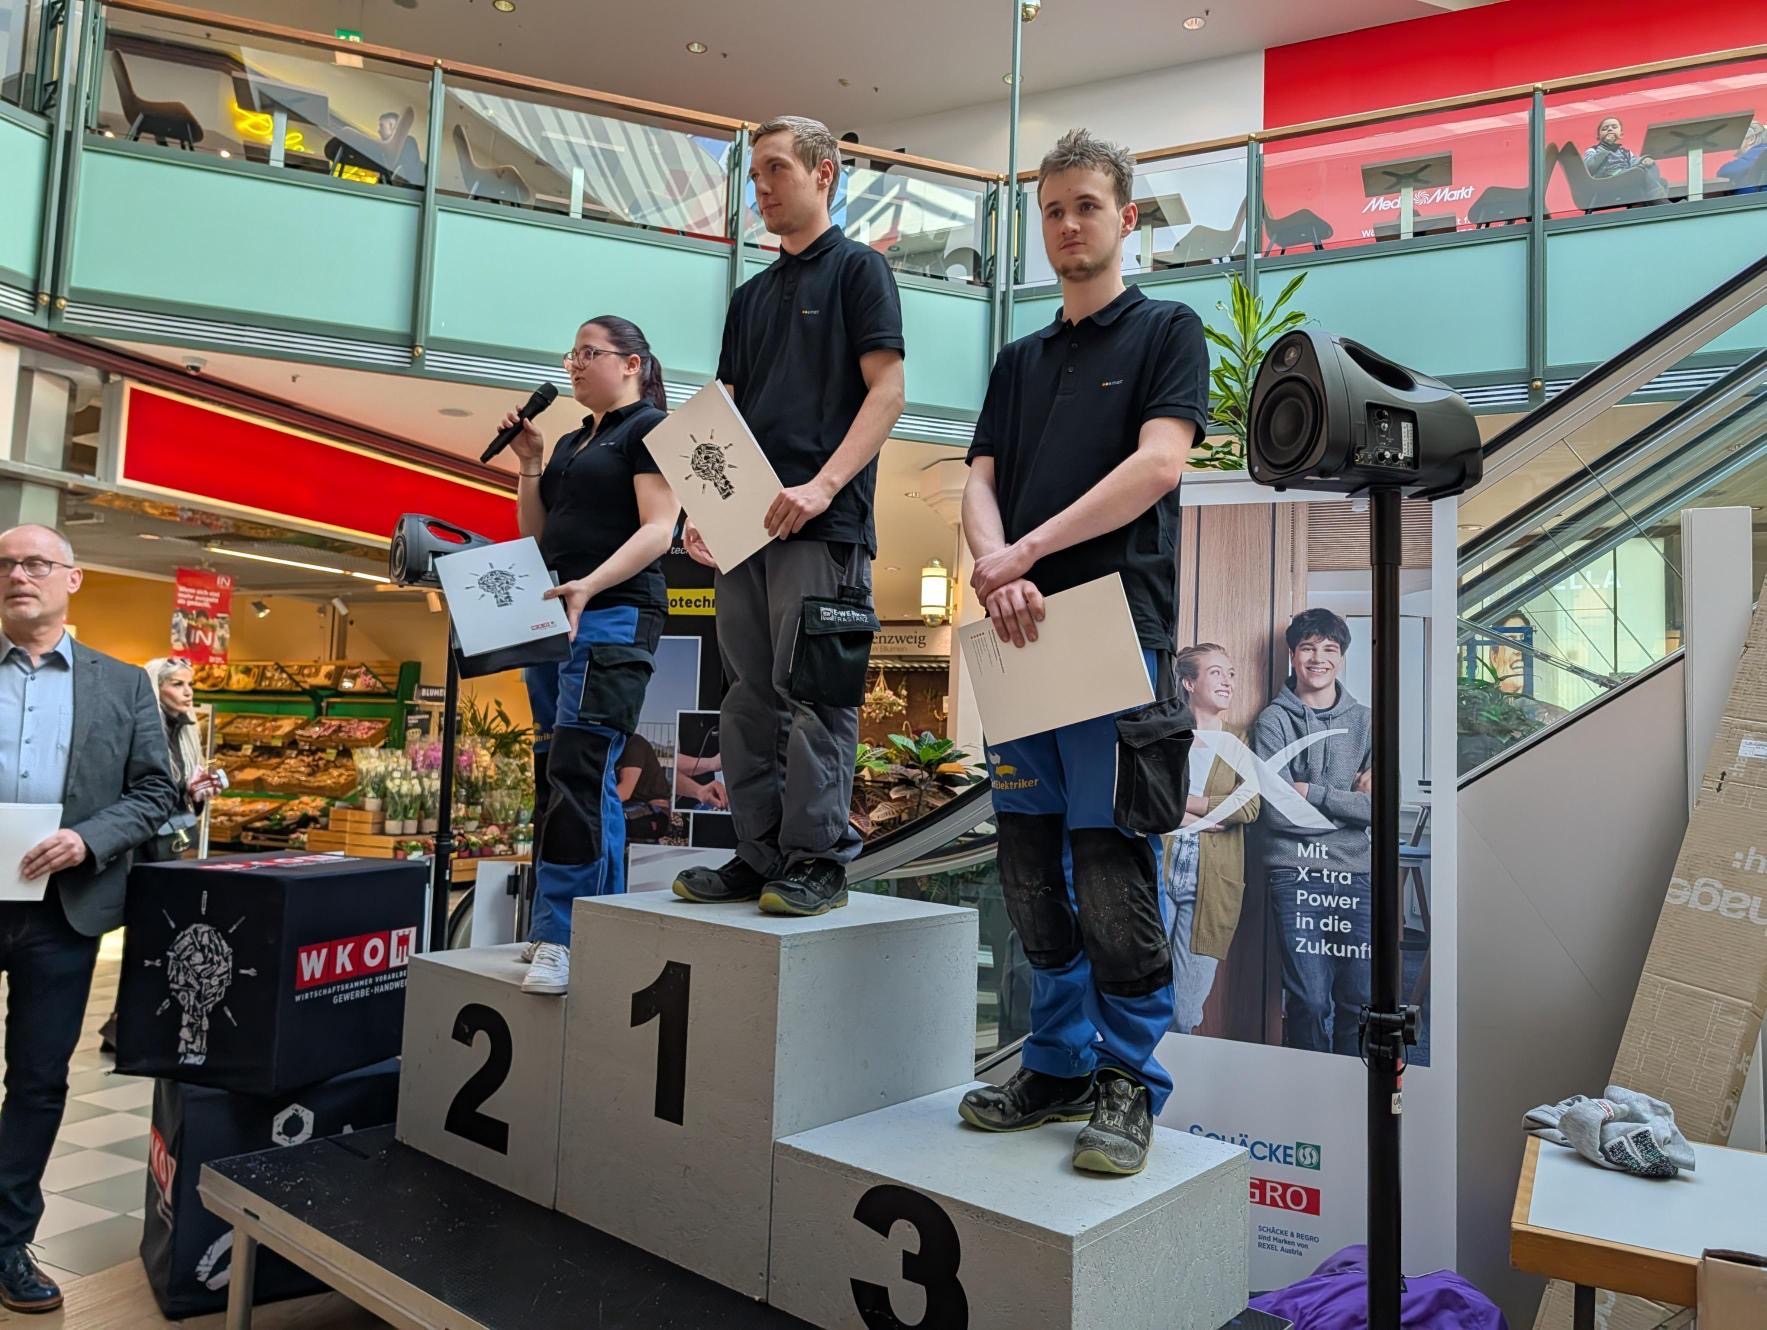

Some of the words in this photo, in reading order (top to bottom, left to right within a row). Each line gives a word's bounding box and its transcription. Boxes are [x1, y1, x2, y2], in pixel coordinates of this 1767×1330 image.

[1362, 197, 1402, 213] Med
[1427, 186, 1475, 204] Markt
[216, 575, 231, 587] IN
[190, 629, 213, 647] IN
[421, 687, 446, 697] BLUME
[1297, 842, 1328, 859] Mit
[1297, 866, 1352, 885] X-tra
[1296, 889, 1360, 910] Power
[1296, 911, 1314, 930] in
[1319, 915, 1352, 933] die
[294, 978, 373, 1003] WIRTSCHAFTSKAMMER
[630, 960, 692, 1127] 1
[444, 1003, 513, 1155] 2
[1258, 1225, 1289, 1237] SCHÄCKE
[1296, 1232, 1320, 1243] REGRO
[1258, 1234, 1271, 1242] sind
[1273, 1236, 1296, 1246] Marken
[850, 1184, 969, 1330] 3
[1257, 1241, 1279, 1252] REXEL
[1280, 1246, 1303, 1257] Austria
